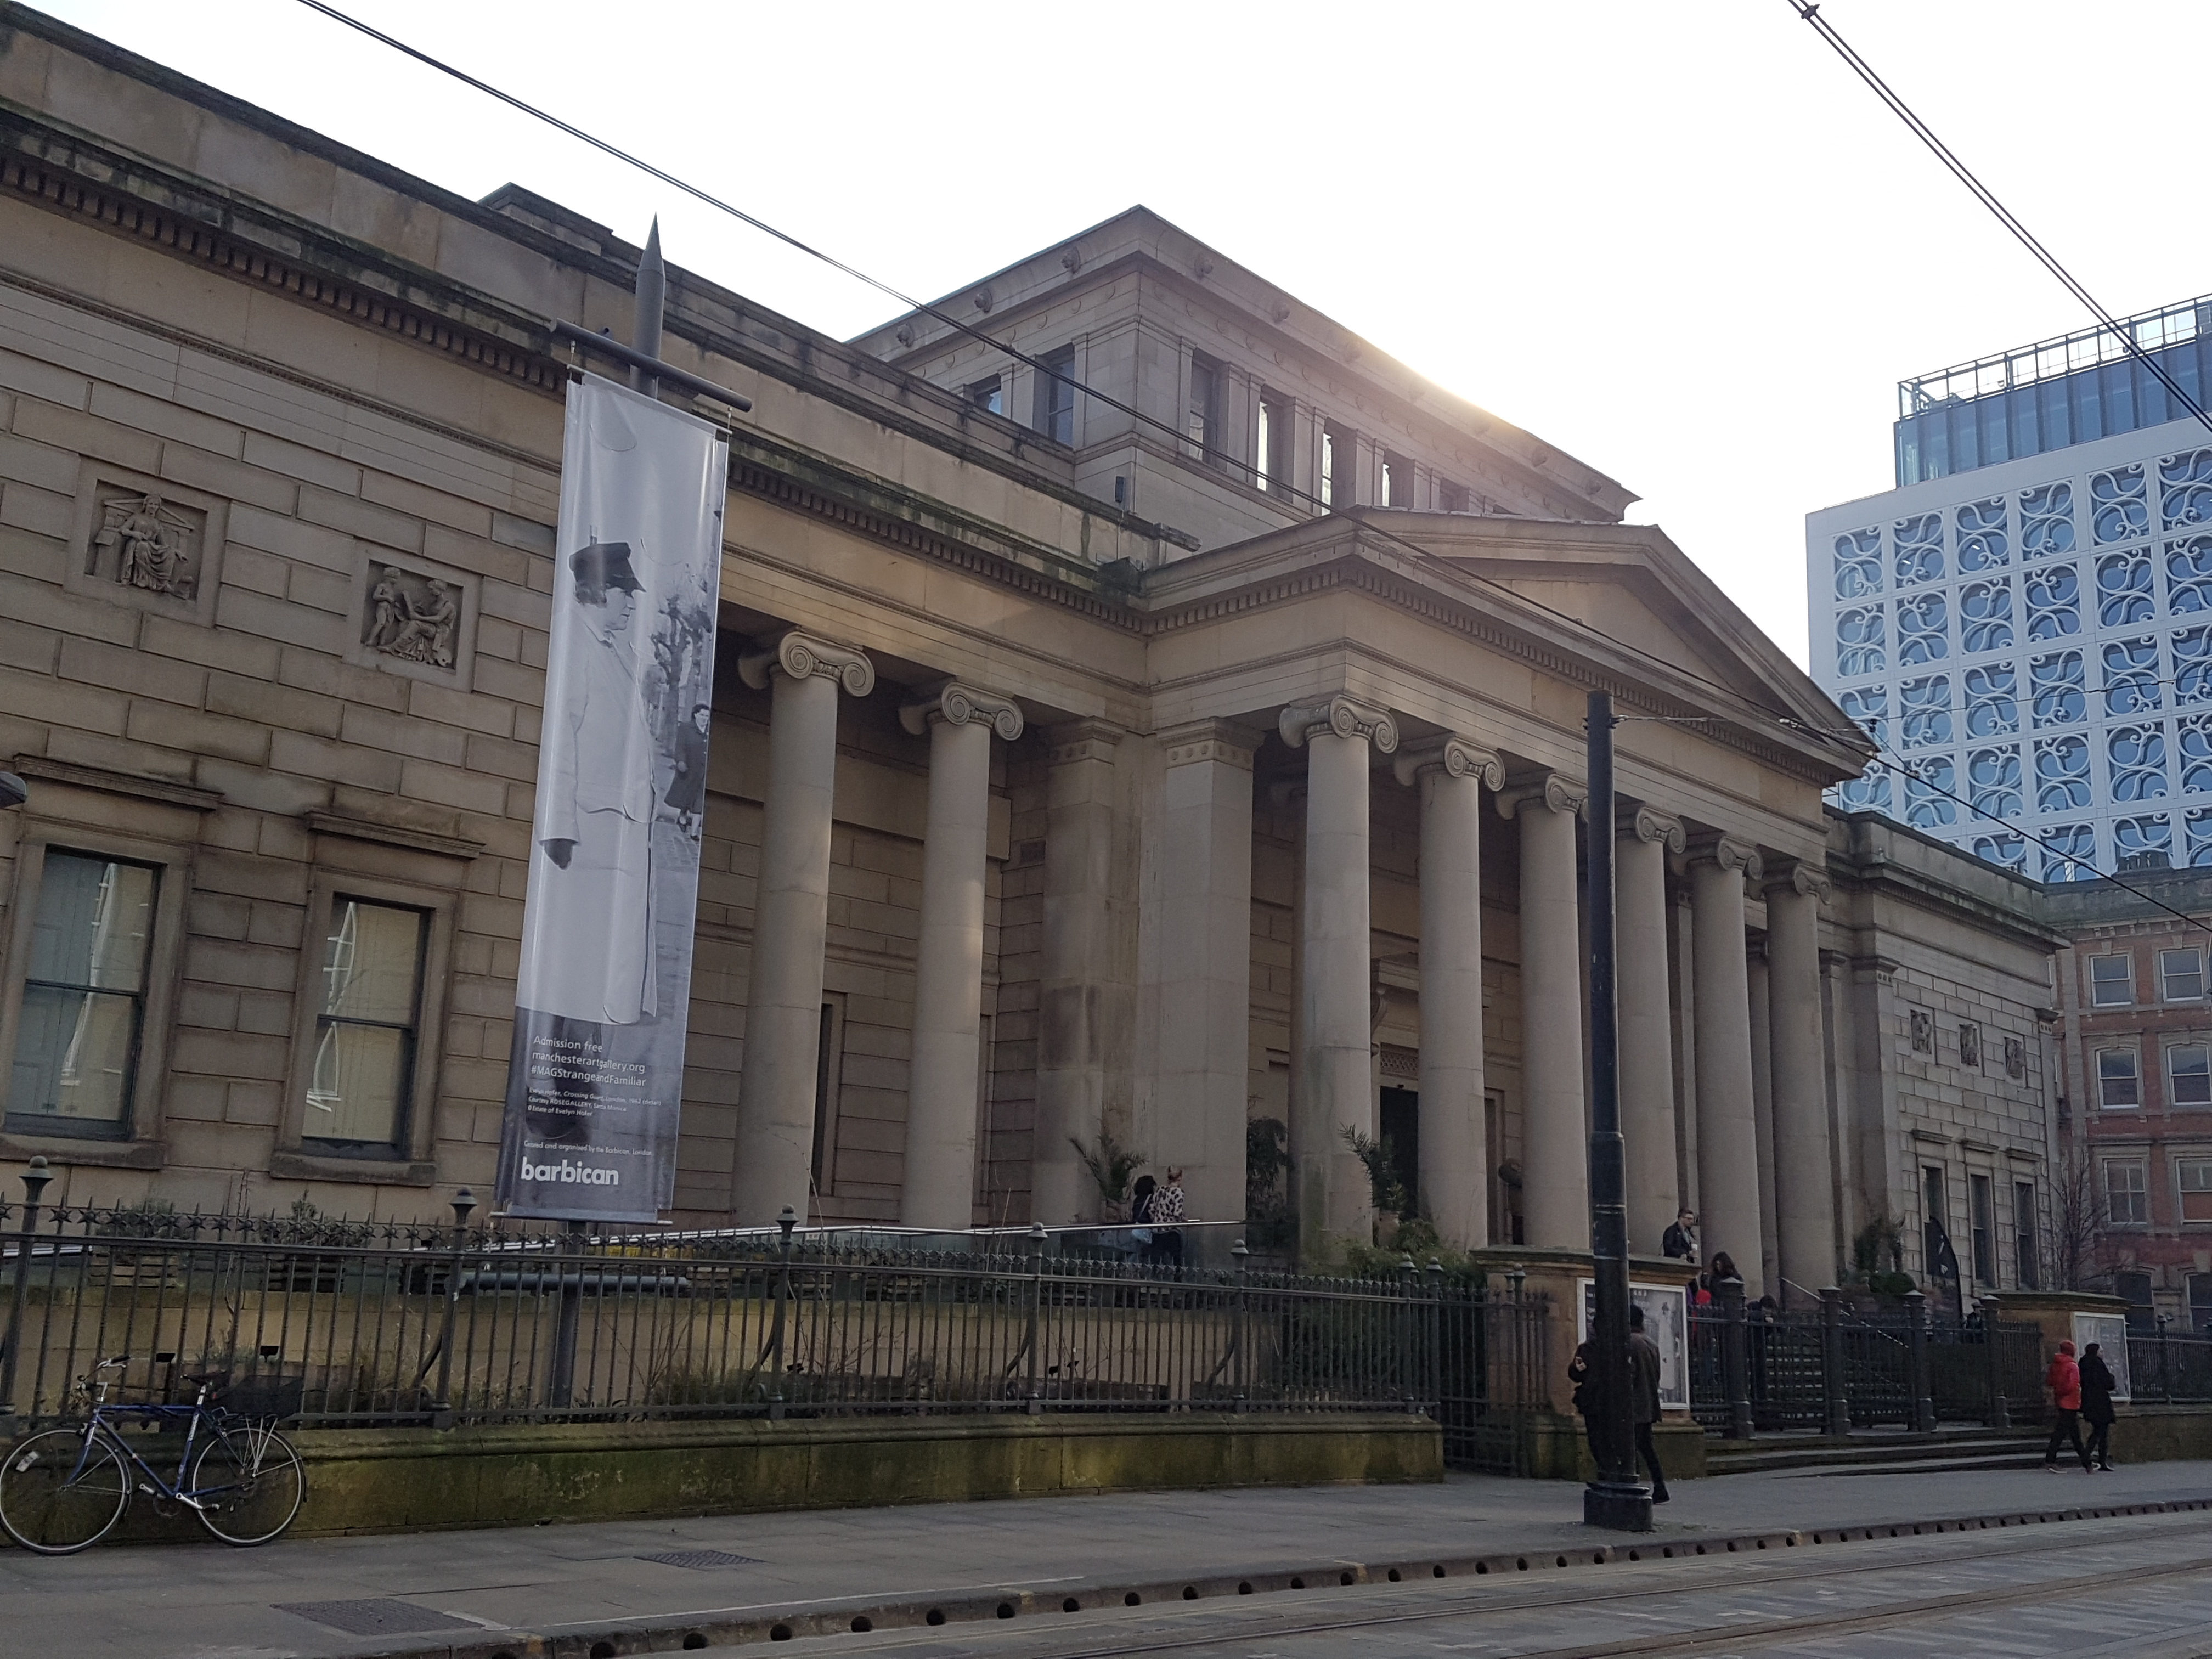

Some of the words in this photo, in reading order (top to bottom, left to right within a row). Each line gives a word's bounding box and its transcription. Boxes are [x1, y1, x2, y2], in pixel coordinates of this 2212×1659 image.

[533, 1035, 582, 1050] Admission
[584, 1041, 603, 1053] free
[532, 1052, 645, 1074] manchesterartgallery.org
[531, 1065, 647, 1087] #MAGStrangeandFamiliar
[555, 1108, 575, 1116] Evelyn
[521, 1156, 619, 1185] barbican
